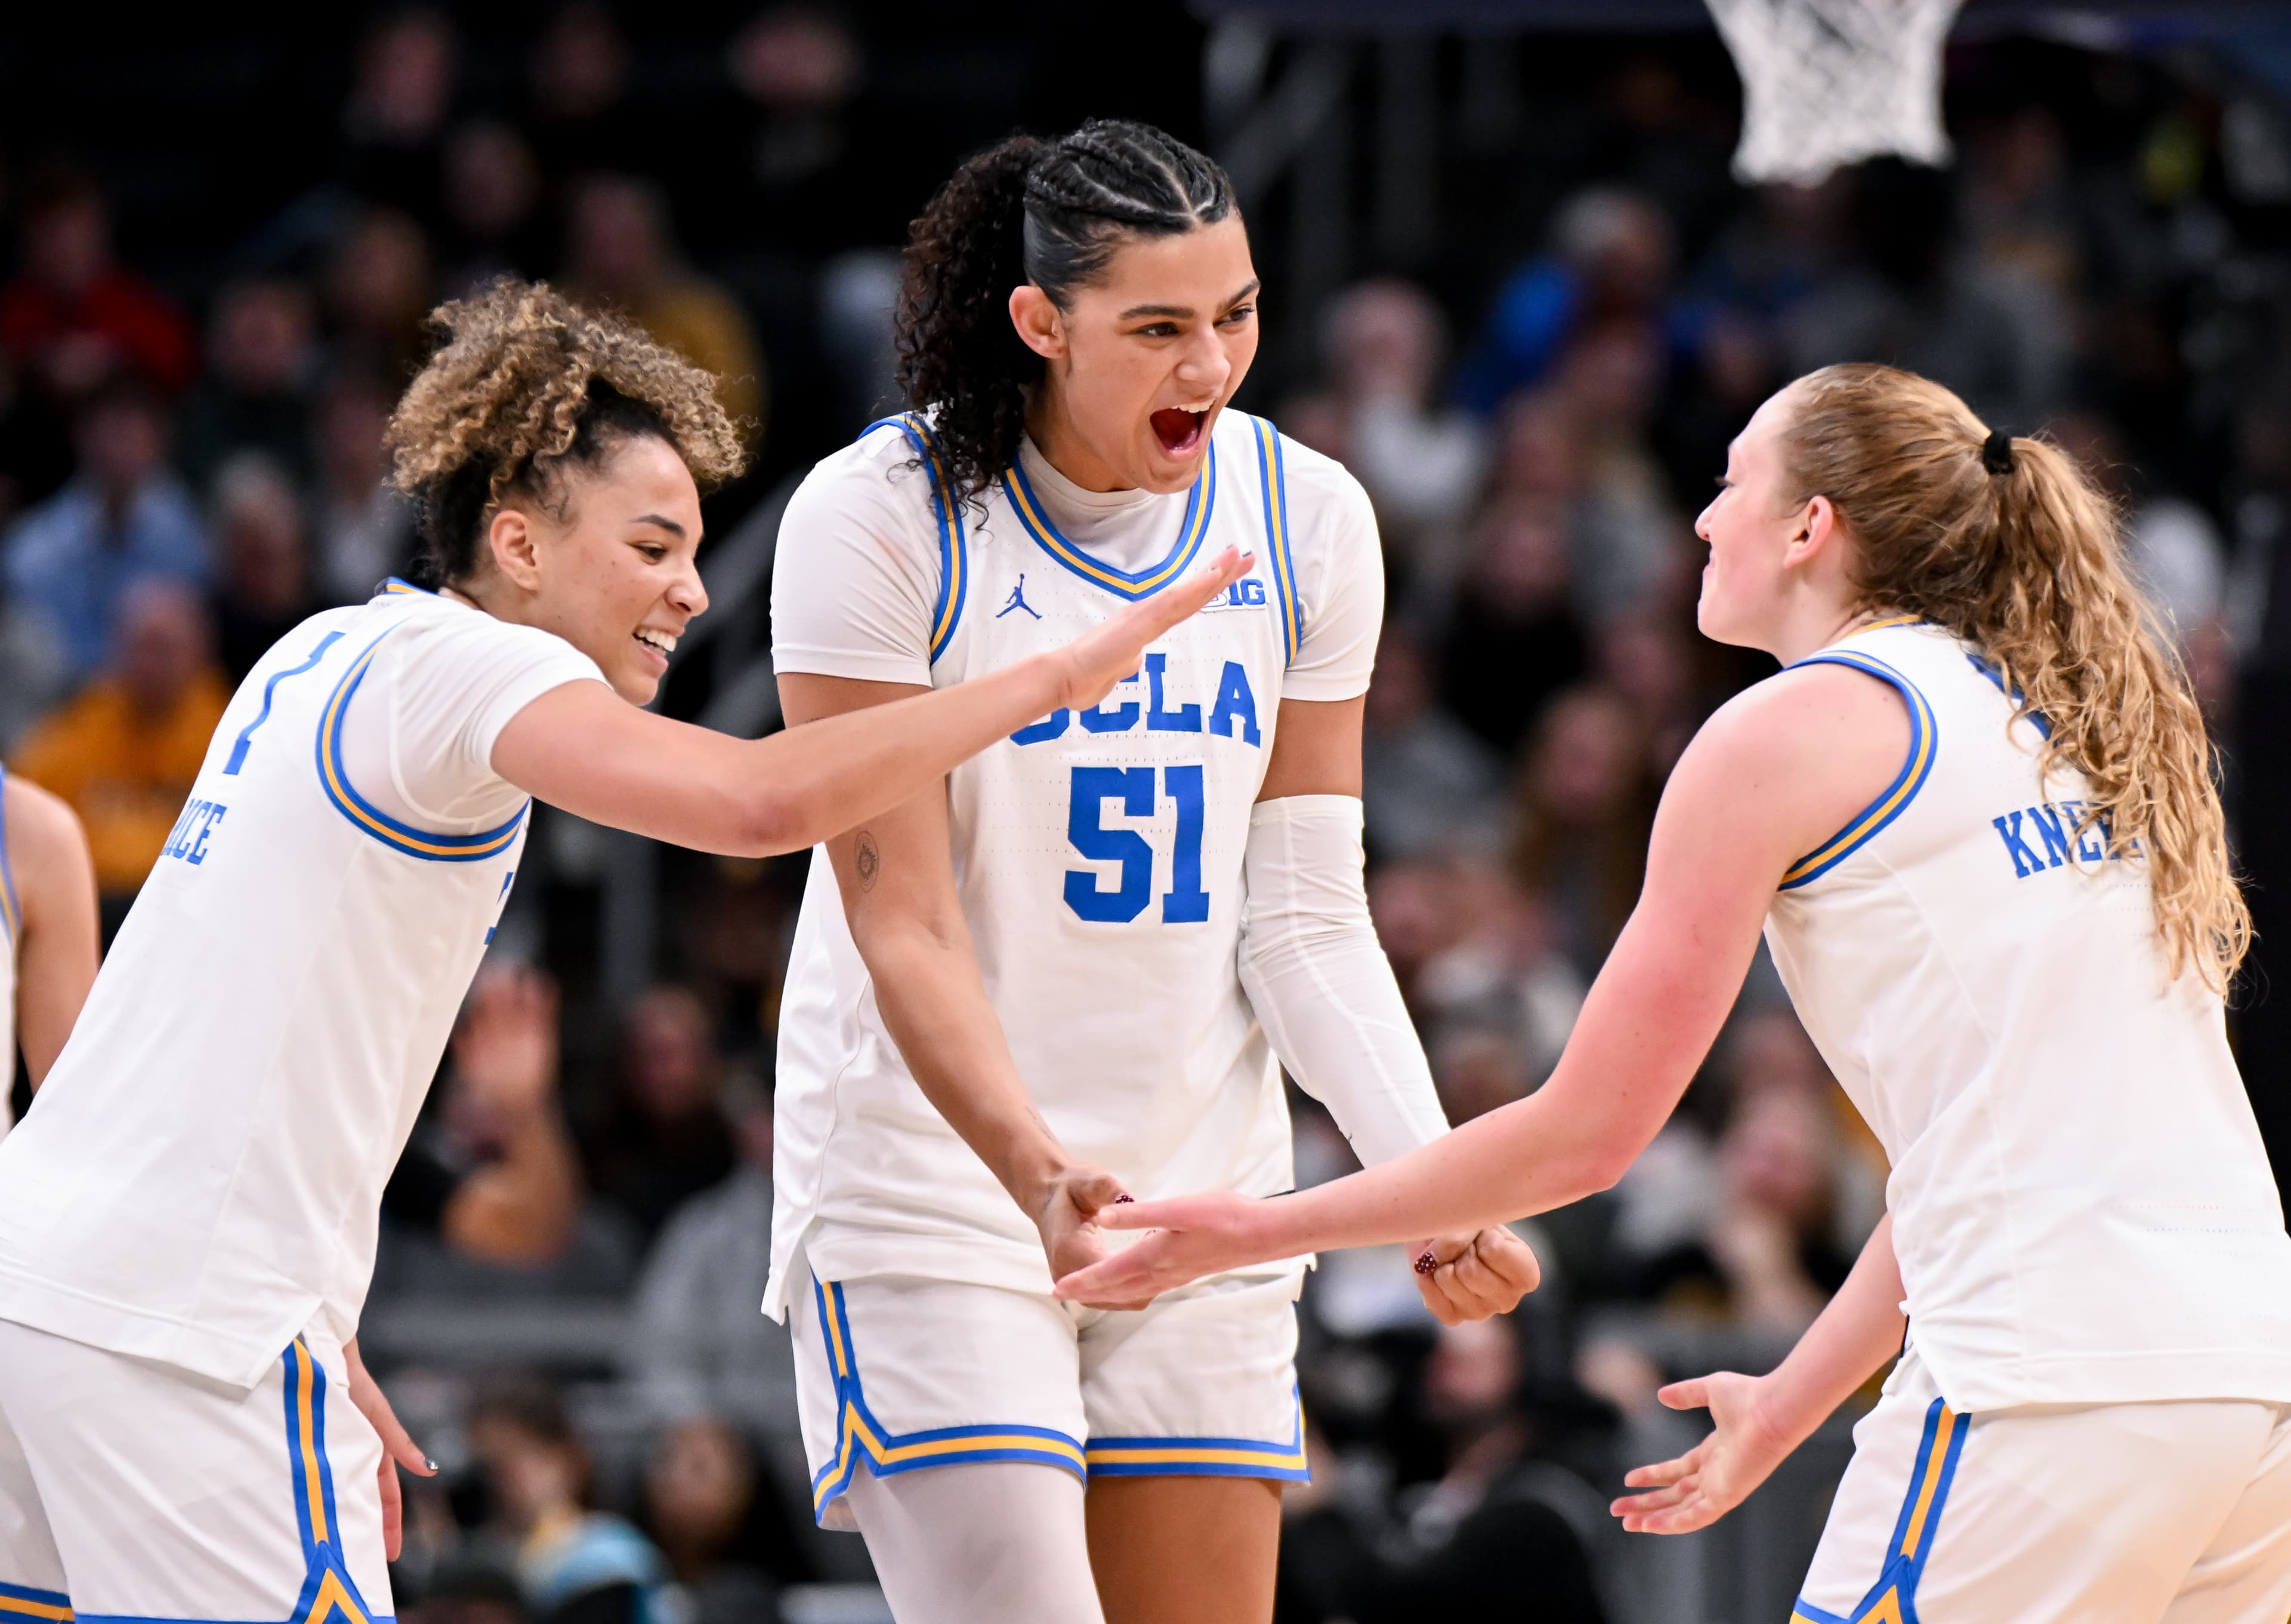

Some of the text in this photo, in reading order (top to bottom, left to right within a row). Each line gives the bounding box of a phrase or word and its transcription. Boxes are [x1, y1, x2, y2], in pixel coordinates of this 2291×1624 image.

[222, 631, 346, 775] 1
[160, 799, 227, 865] ICE
[1063, 764, 1210, 924] 51
